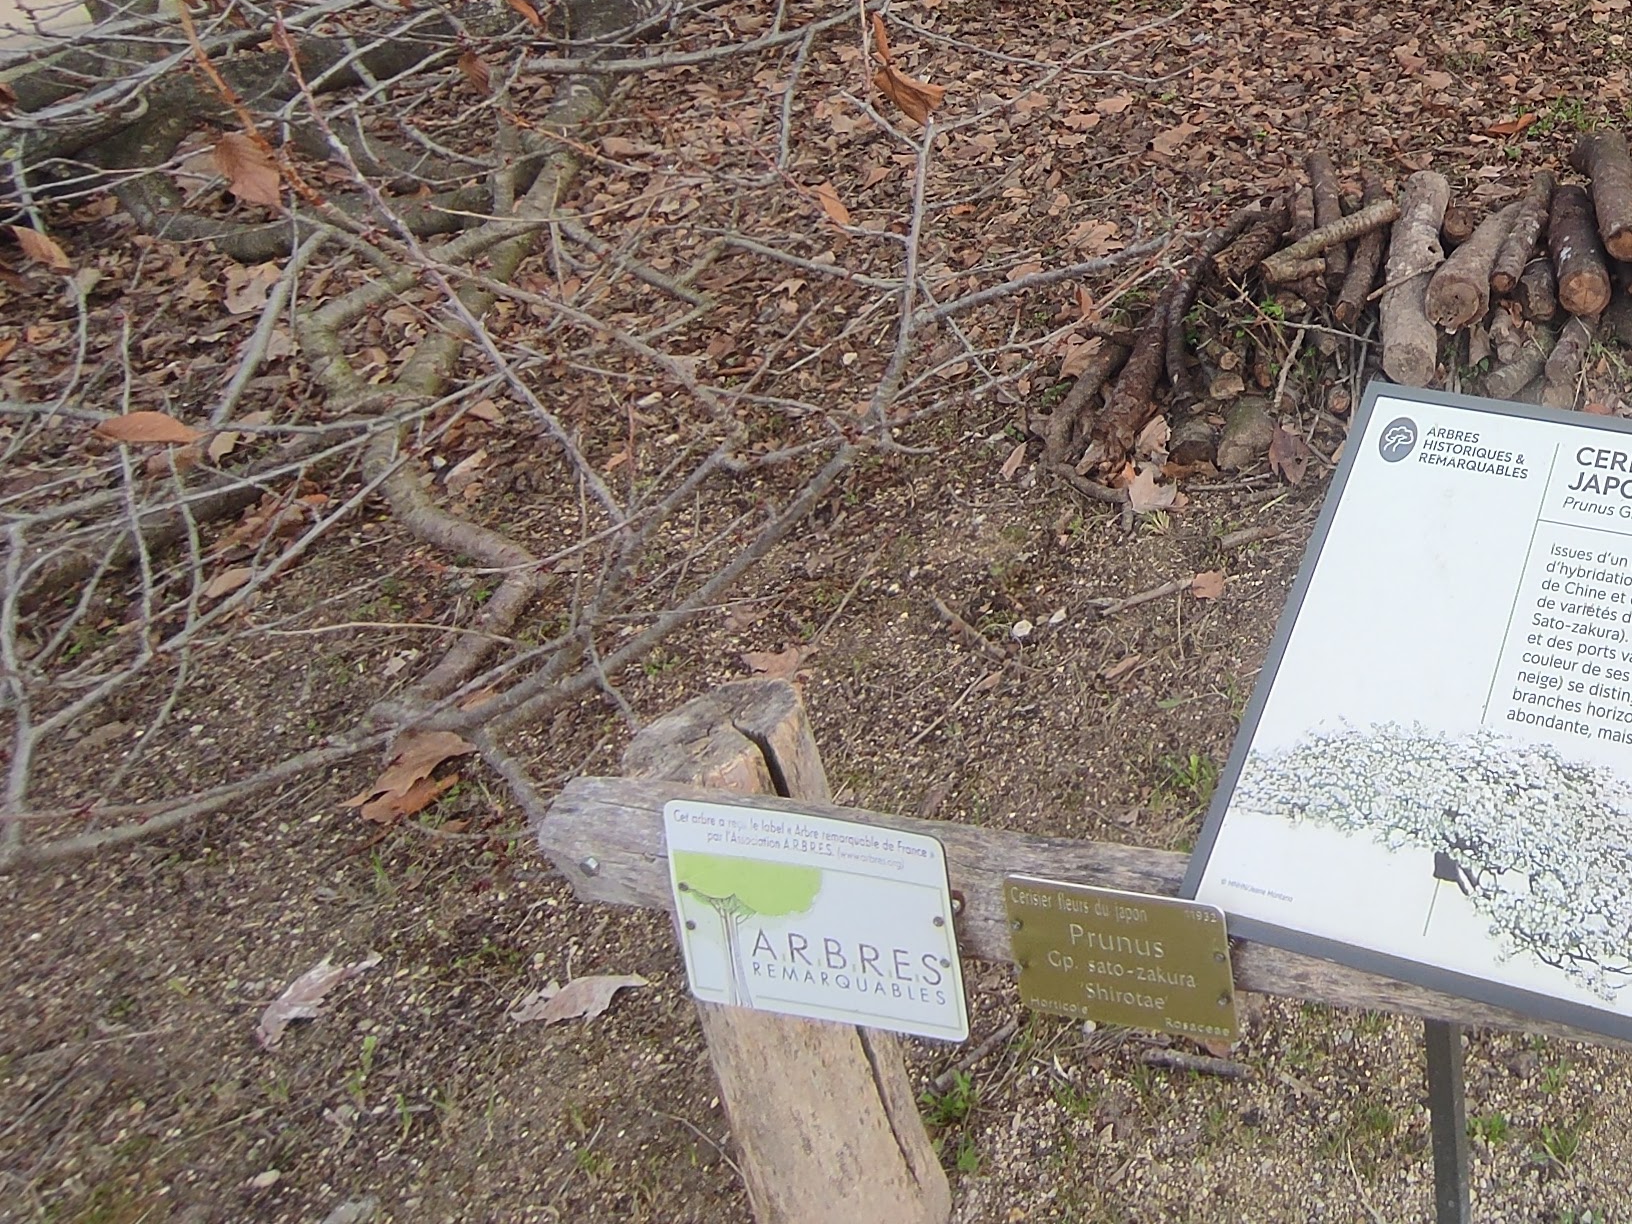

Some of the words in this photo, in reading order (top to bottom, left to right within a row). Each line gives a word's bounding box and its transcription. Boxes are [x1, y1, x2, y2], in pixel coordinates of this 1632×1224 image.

[1425, 426, 1480, 444] ARBRES
[1417, 451, 1528, 479] REMARQUABLES
[1422, 438, 1513, 463] HISTORIQUES
[1514, 453, 1525, 465] &
[1561, 495, 1615, 516] Prunus
[1540, 577, 1560, 592] de
[1563, 580, 1607, 600] Chine
[1609, 591, 1626, 604] et
[1536, 595, 1556, 610] de
[1559, 601, 1618, 621] variétés
[1531, 611, 1628, 644] Sato-zakura).
[1526, 632, 1543, 646] et
[1545, 634, 1573, 652] des
[1575, 642, 1617, 660] ports
[1521, 651, 1579, 672] couleur
[1580, 660, 1601, 676] de
[1604, 667, 1630, 682] ses
[1516, 670, 1563, 691] neige)
[1566, 680, 1584, 693] se
[1511, 685, 1582, 713] branches
[1505, 706, 1592, 739] abondante,
[692, 811, 716, 826] arbre
[718, 818, 725, 827] a
[761, 819, 785, 834] label
[795, 824, 818, 839] Arbre
[822, 829, 880, 849] remarquable
[882, 839, 895, 852] de
[897, 840, 928, 858] France
[1010, 886, 1052, 908] Cerisier
[1058, 892, 1089, 914] fleurs
[1095, 898, 1109, 917] du
[1115, 902, 1148, 923] japon
[1069, 923, 1165, 958] Prunus
[1048, 950, 1078, 972] Gp.
[1088, 959, 1196, 988] sato-zakura
[753, 962, 946, 1006] REMARQUABLES
[1030, 995, 1088, 1015] Horticole
[1165, 1017, 1230, 1036] Rosaceae
